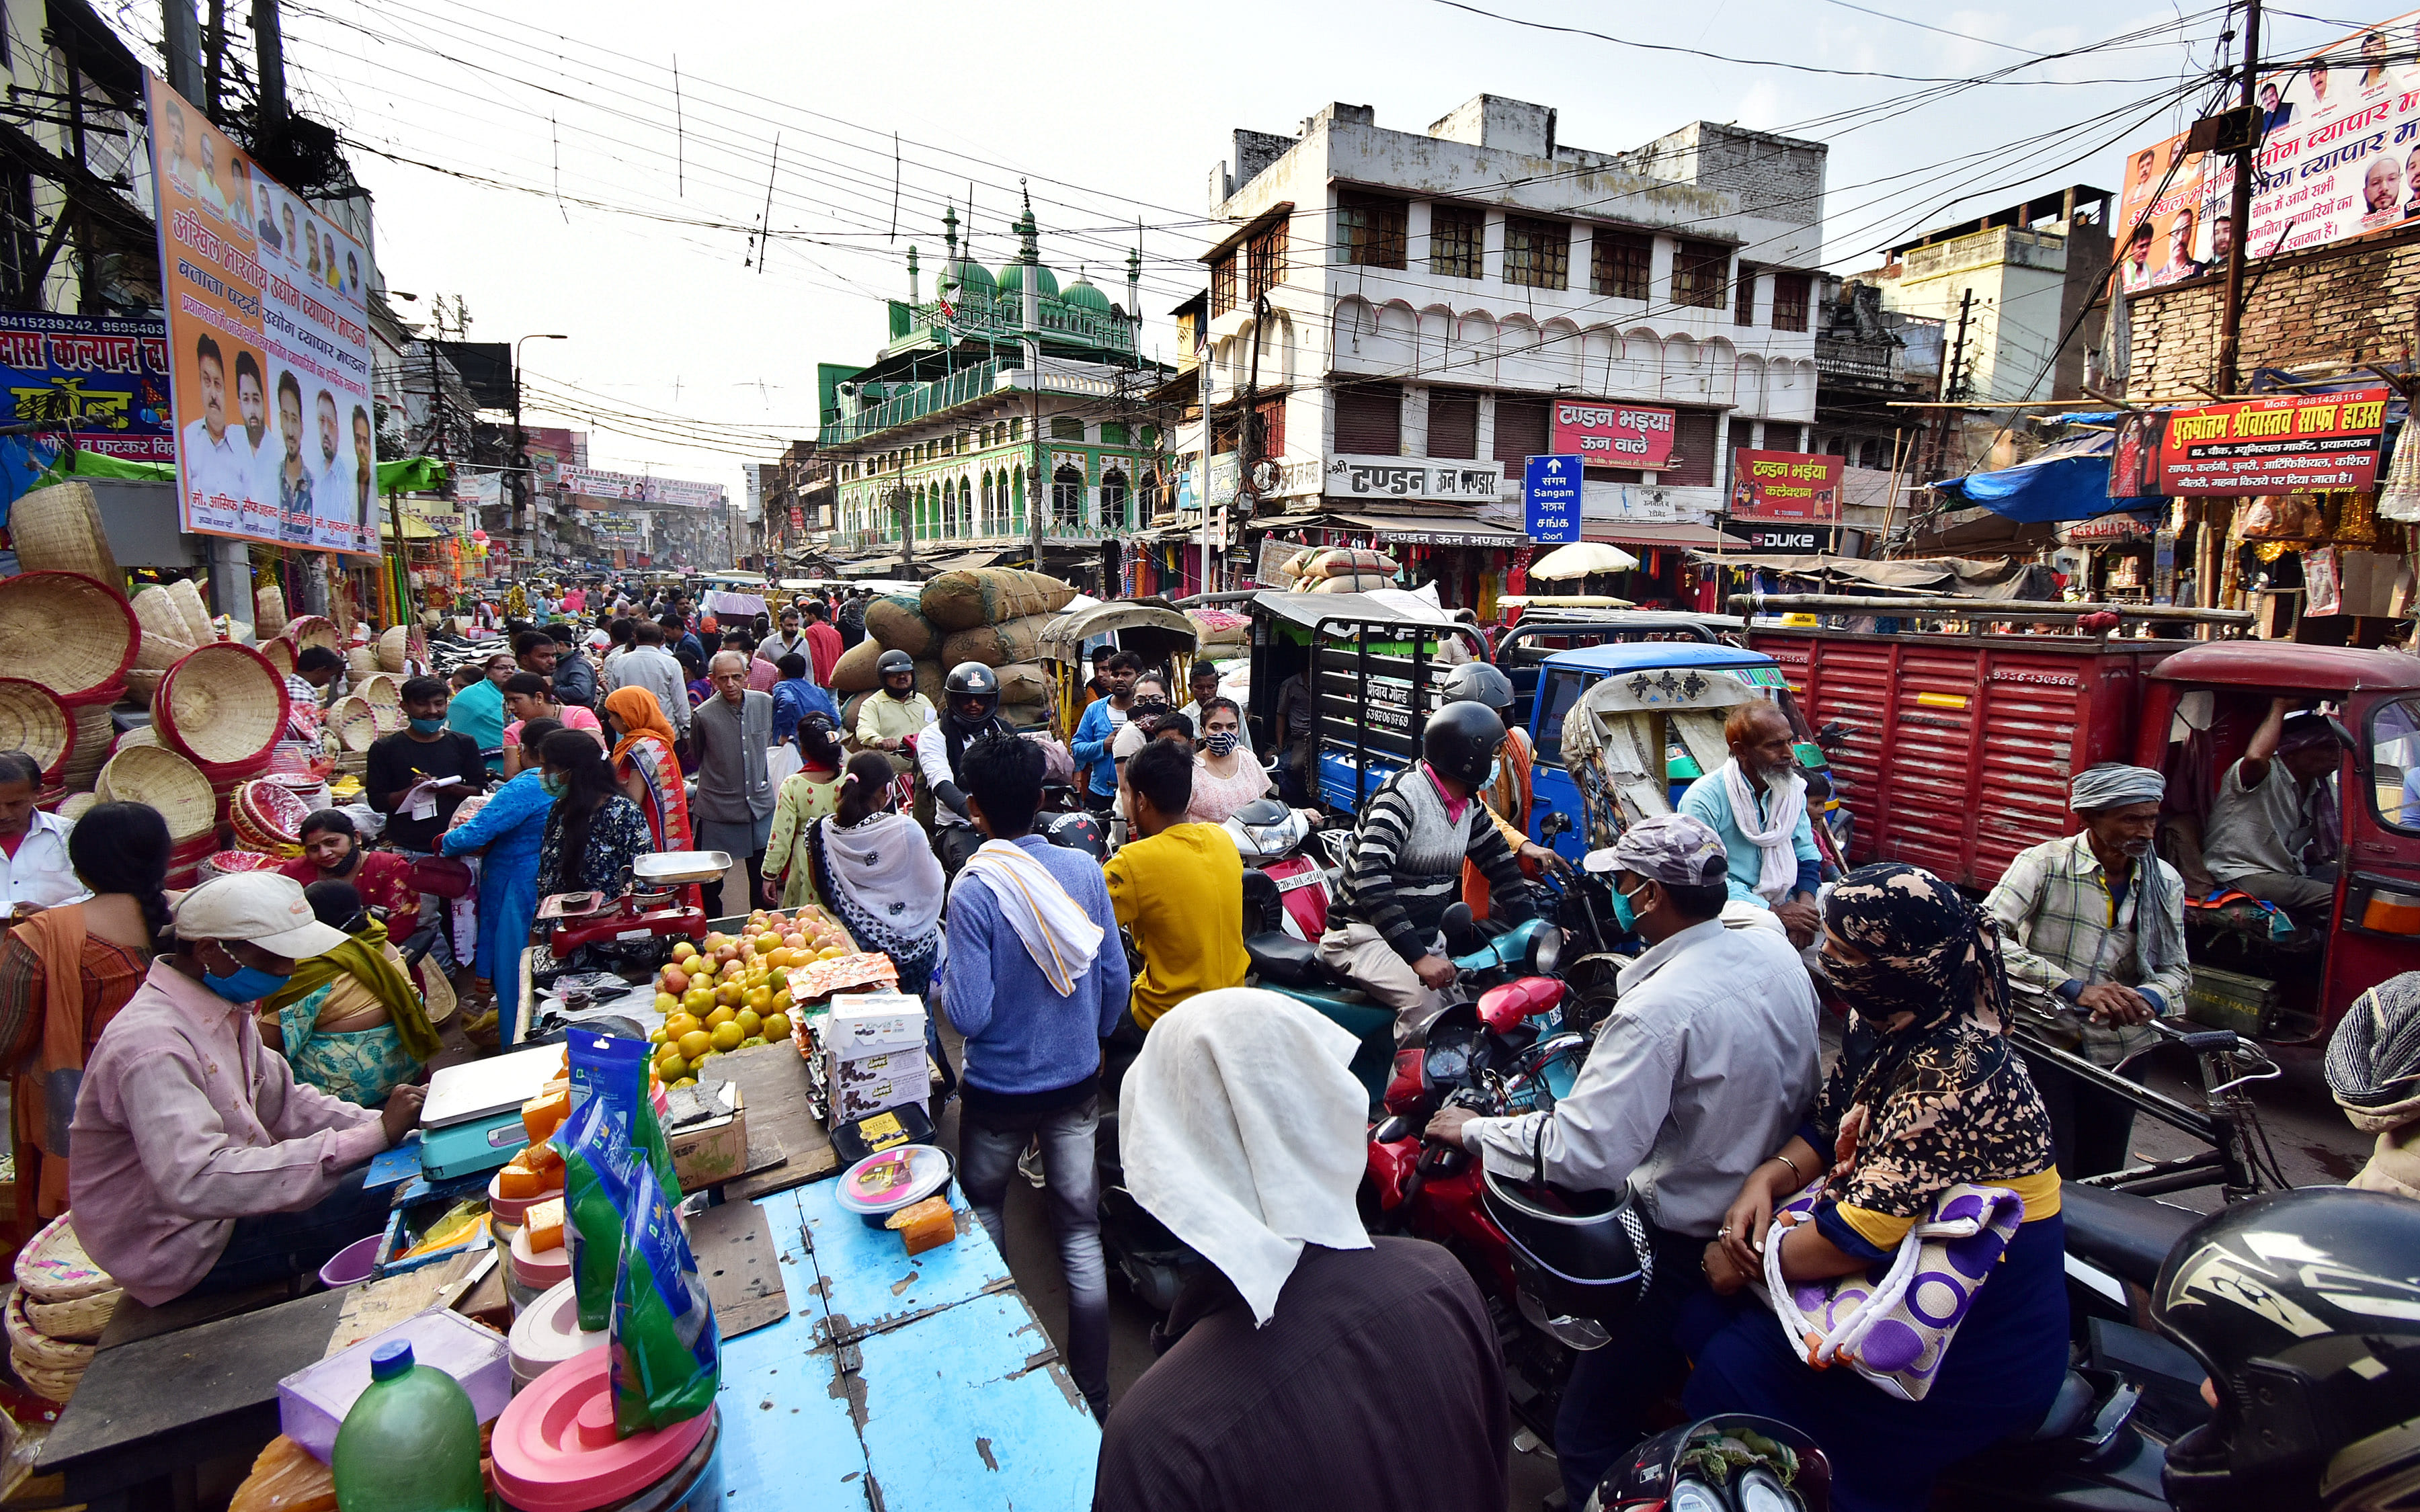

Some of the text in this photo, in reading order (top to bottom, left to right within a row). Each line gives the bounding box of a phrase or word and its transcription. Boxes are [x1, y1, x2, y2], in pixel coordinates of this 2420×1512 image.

[2307, 99, 2392, 149] व्यापार
[2300, 130, 2388, 179] व्यापार
[2252, 175, 2335, 218] चौक में आये सभी
[2246, 220, 2282, 243] म्मानित
[2337, 195, 2353, 208] का
[2287, 228, 2322, 250] स्वागत
[173, 208, 221, 263] अखिल
[223, 243, 268, 291] भारतीय
[270, 274, 300, 310] उद्योग
[302, 295, 336, 332] व्यापार
[338, 315, 366, 348] मण्डल
[182, 294, 217, 328] प्रयागराज
[262, 306, 296, 337] उद्योग
[298, 327, 335, 358] व्यापार
[337, 348, 367, 374] मण्डल
[2263, 392, 2363, 409] Mob.: 8081428116
[1558, 405, 1615, 428] टण्डन
[2232, 405, 2295, 437] श्रीवास्तव
[2298, 405, 2339, 433] साफा
[2341, 401, 2386, 430] हाउस
[96, 440, 150, 455] फुटकर
[1580, 435, 1649, 454] ऊन वाले
[2320, 439, 2372, 450] प्रयागराज
[1752, 458, 1828, 482] टन्डन भईया
[2168, 464, 2194, 473] साफा,
[2196, 460, 2230, 472] कलंगी,
[2232, 459, 2259, 474] चुनरी,
[1331, 460, 1348, 474] श्री
[1349, 464, 1427, 495] टण्डन
[1435, 469, 1458, 493] ऊन
[1541, 474, 1566, 486] संगम
[2211, 478, 2238, 487] गहना
[2239, 475, 2269, 487] किराये
[2271, 476, 2286, 485] पर
[2287, 473, 2310, 485] दिया
[2311, 474, 2336, 484] जाता
[2338, 471, 2353, 484] है।
[1534, 489, 1574, 499] Sangam
[1765, 483, 1812, 499] कलेक्शन
[209, 493, 238, 511] आसिफ
[242, 497, 258, 513] सैफ
[415, 515, 462, 525] AGEER
[1387, 532, 1430, 543] टण्डन
[1436, 534, 1463, 545] ऊन
[1469, 536, 1517, 546] भण्डार
[1366, 679, 1408, 704] शिवाय गोल्ड
[1365, 708, 1409, 728] 6387068769
